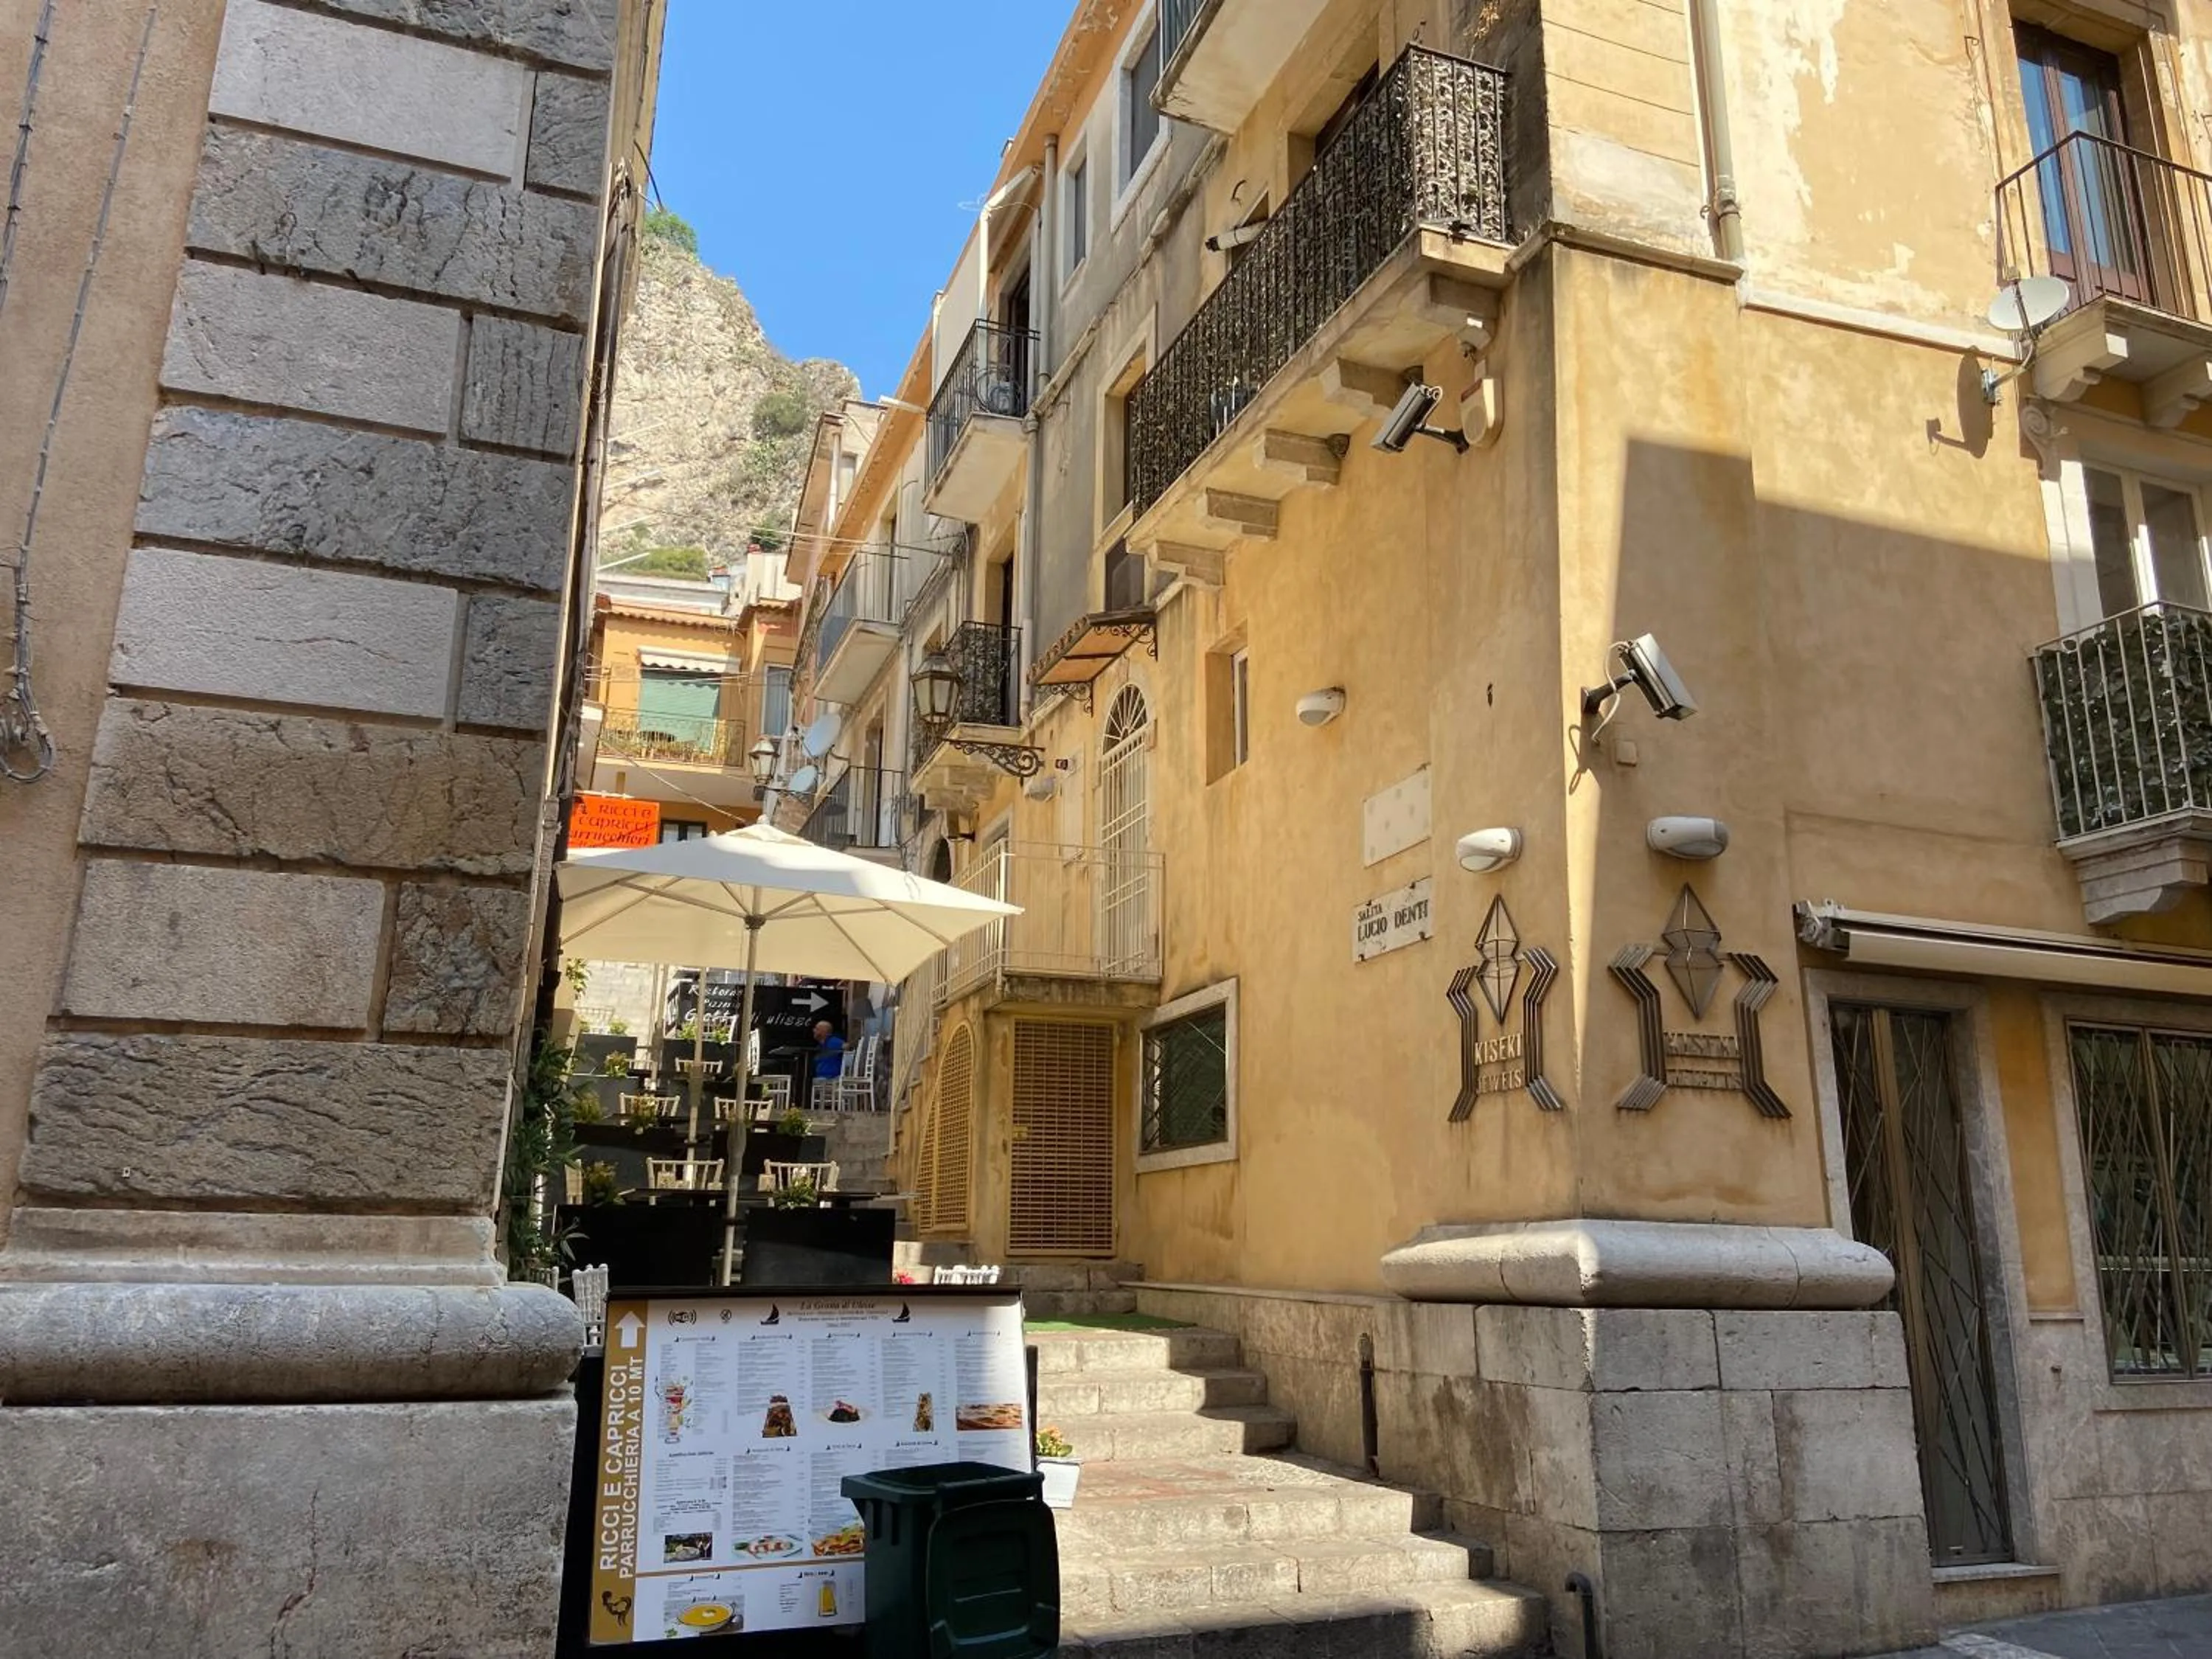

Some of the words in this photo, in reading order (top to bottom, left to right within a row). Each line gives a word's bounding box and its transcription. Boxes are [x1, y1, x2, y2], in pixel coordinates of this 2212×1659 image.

[1357, 917, 1388, 942] LUCIO
[1394, 899, 1428, 929] DENTI
[1475, 1032, 1521, 1066] KISEKI
[630, 1357, 644, 1380] MT
[629, 1386, 642, 1404] 10
[605, 1365, 627, 1474] CAPRICCI
[627, 1409, 640, 1422] A
[604, 1481, 621, 1496] E
[619, 1425, 640, 1579] PARRUCCHIERIA
[599, 1504, 620, 1570] RICCI
